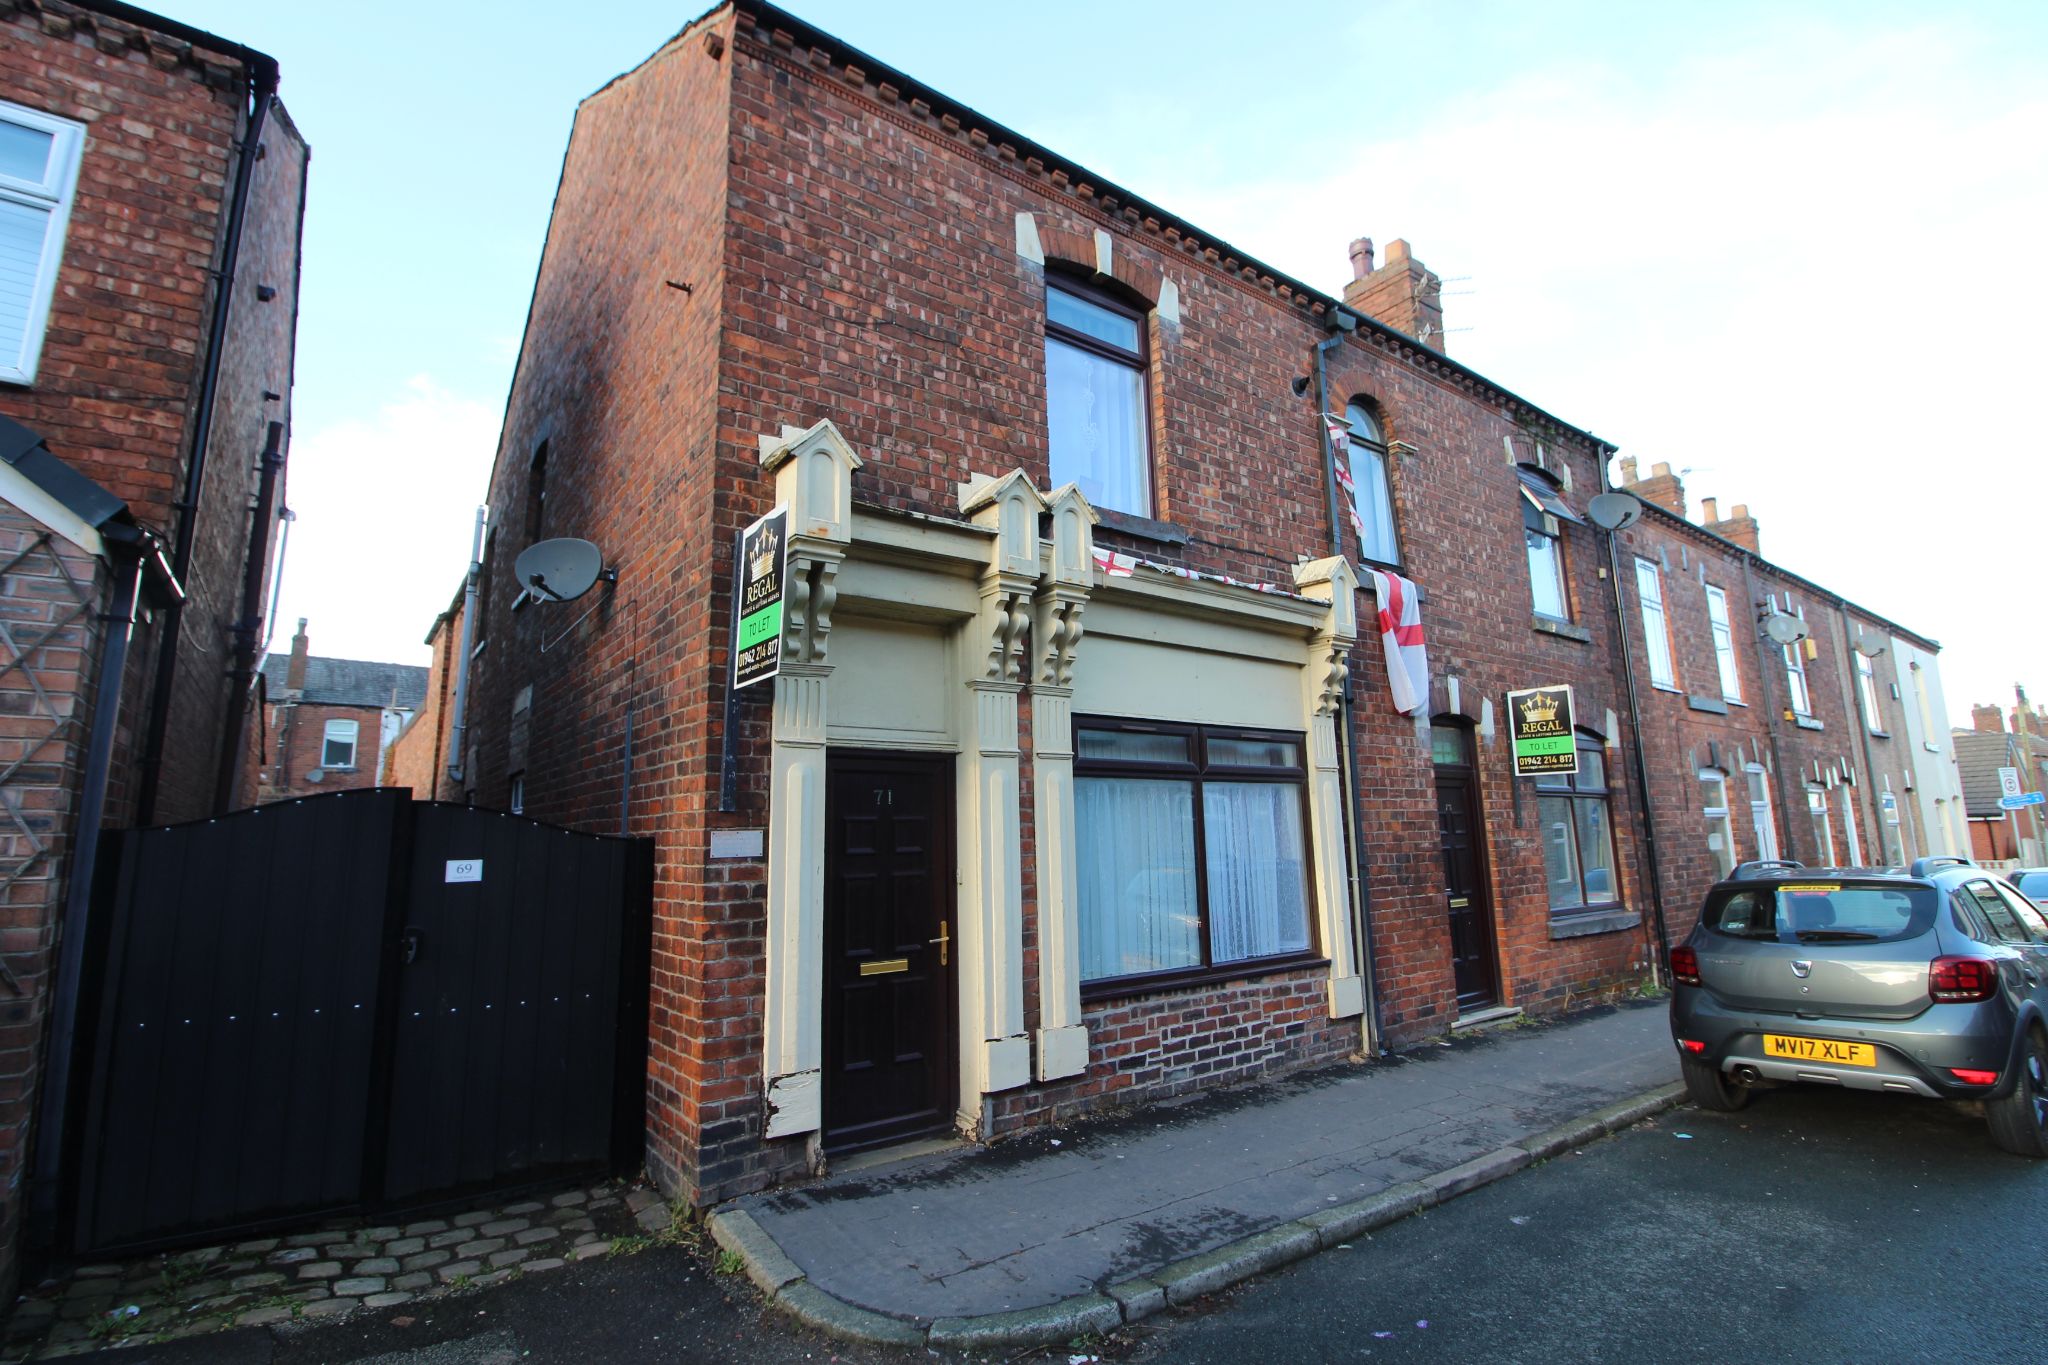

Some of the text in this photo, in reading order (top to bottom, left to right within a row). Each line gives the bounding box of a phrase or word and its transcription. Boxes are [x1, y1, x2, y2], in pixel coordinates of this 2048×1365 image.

[746, 573, 777, 604] REGAL
[749, 615, 770, 637] TO LET
[738, 638, 778, 668] 01942 214 817
[1522, 721, 1563, 732] REGAL
[1529, 741, 1558, 751] TO LET
[1519, 754, 1573, 766] 01942 214 817
[873, 789, 892, 805] 71
[456, 863, 473, 874] 69
[1775, 1037, 1860, 1061] MV17 XLF
